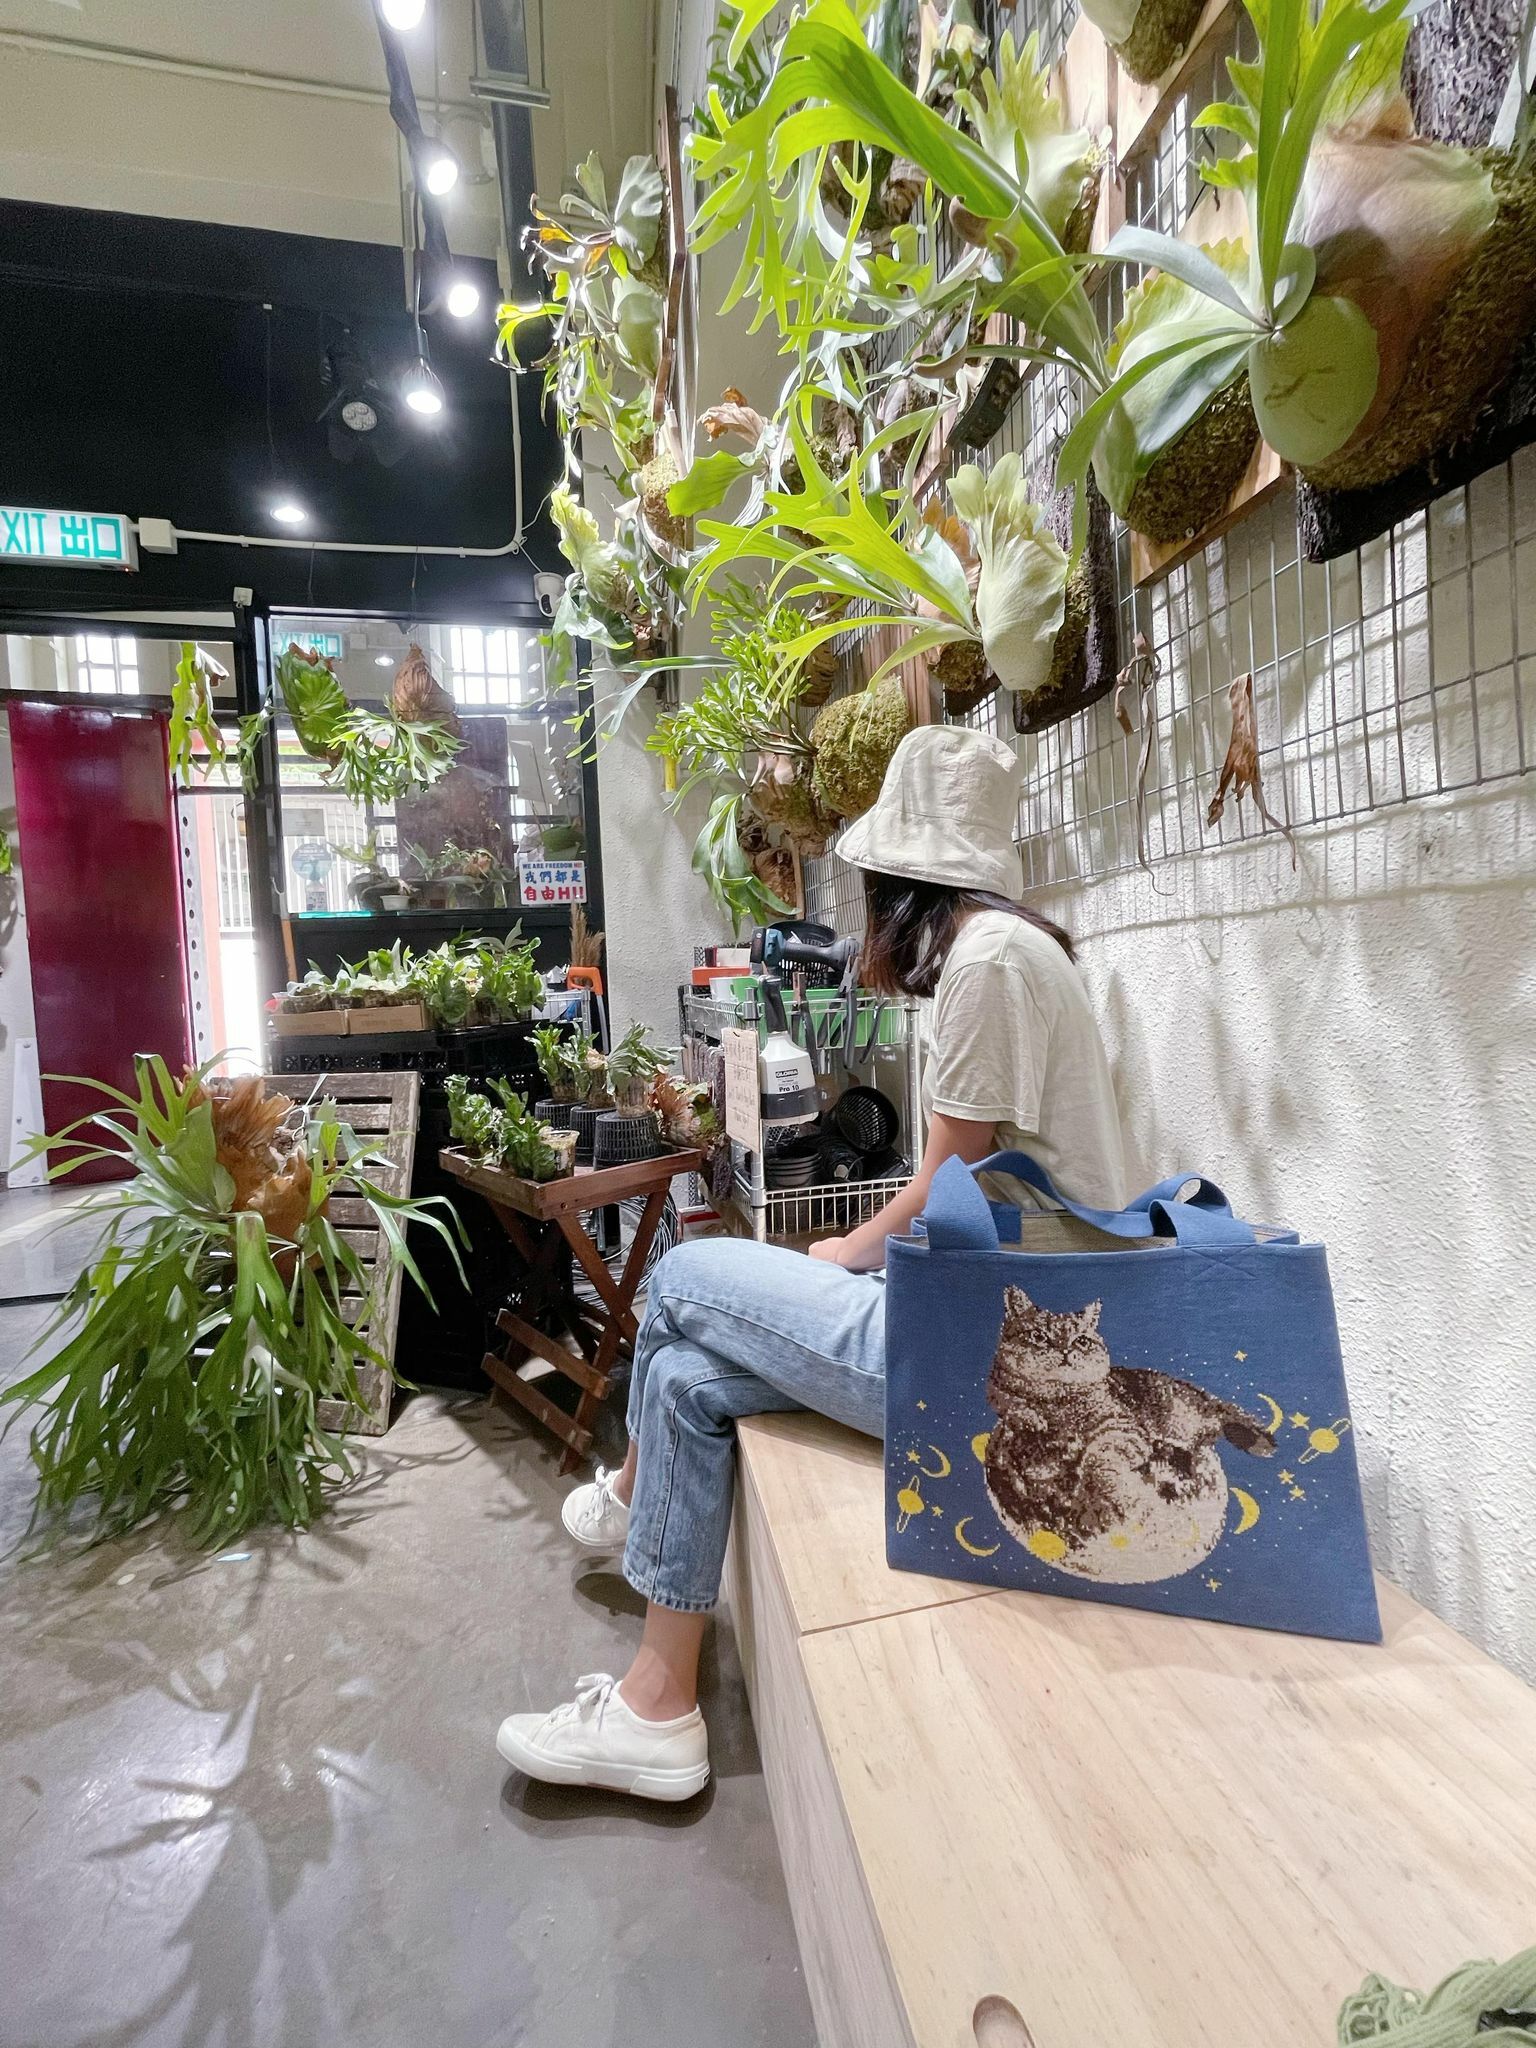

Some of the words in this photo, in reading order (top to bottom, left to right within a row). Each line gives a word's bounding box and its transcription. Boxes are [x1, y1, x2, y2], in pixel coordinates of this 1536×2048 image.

[0, 511, 47, 554] XIT
[59, 516, 122, 559] 出口
[525, 870, 582, 884] 我們都是
